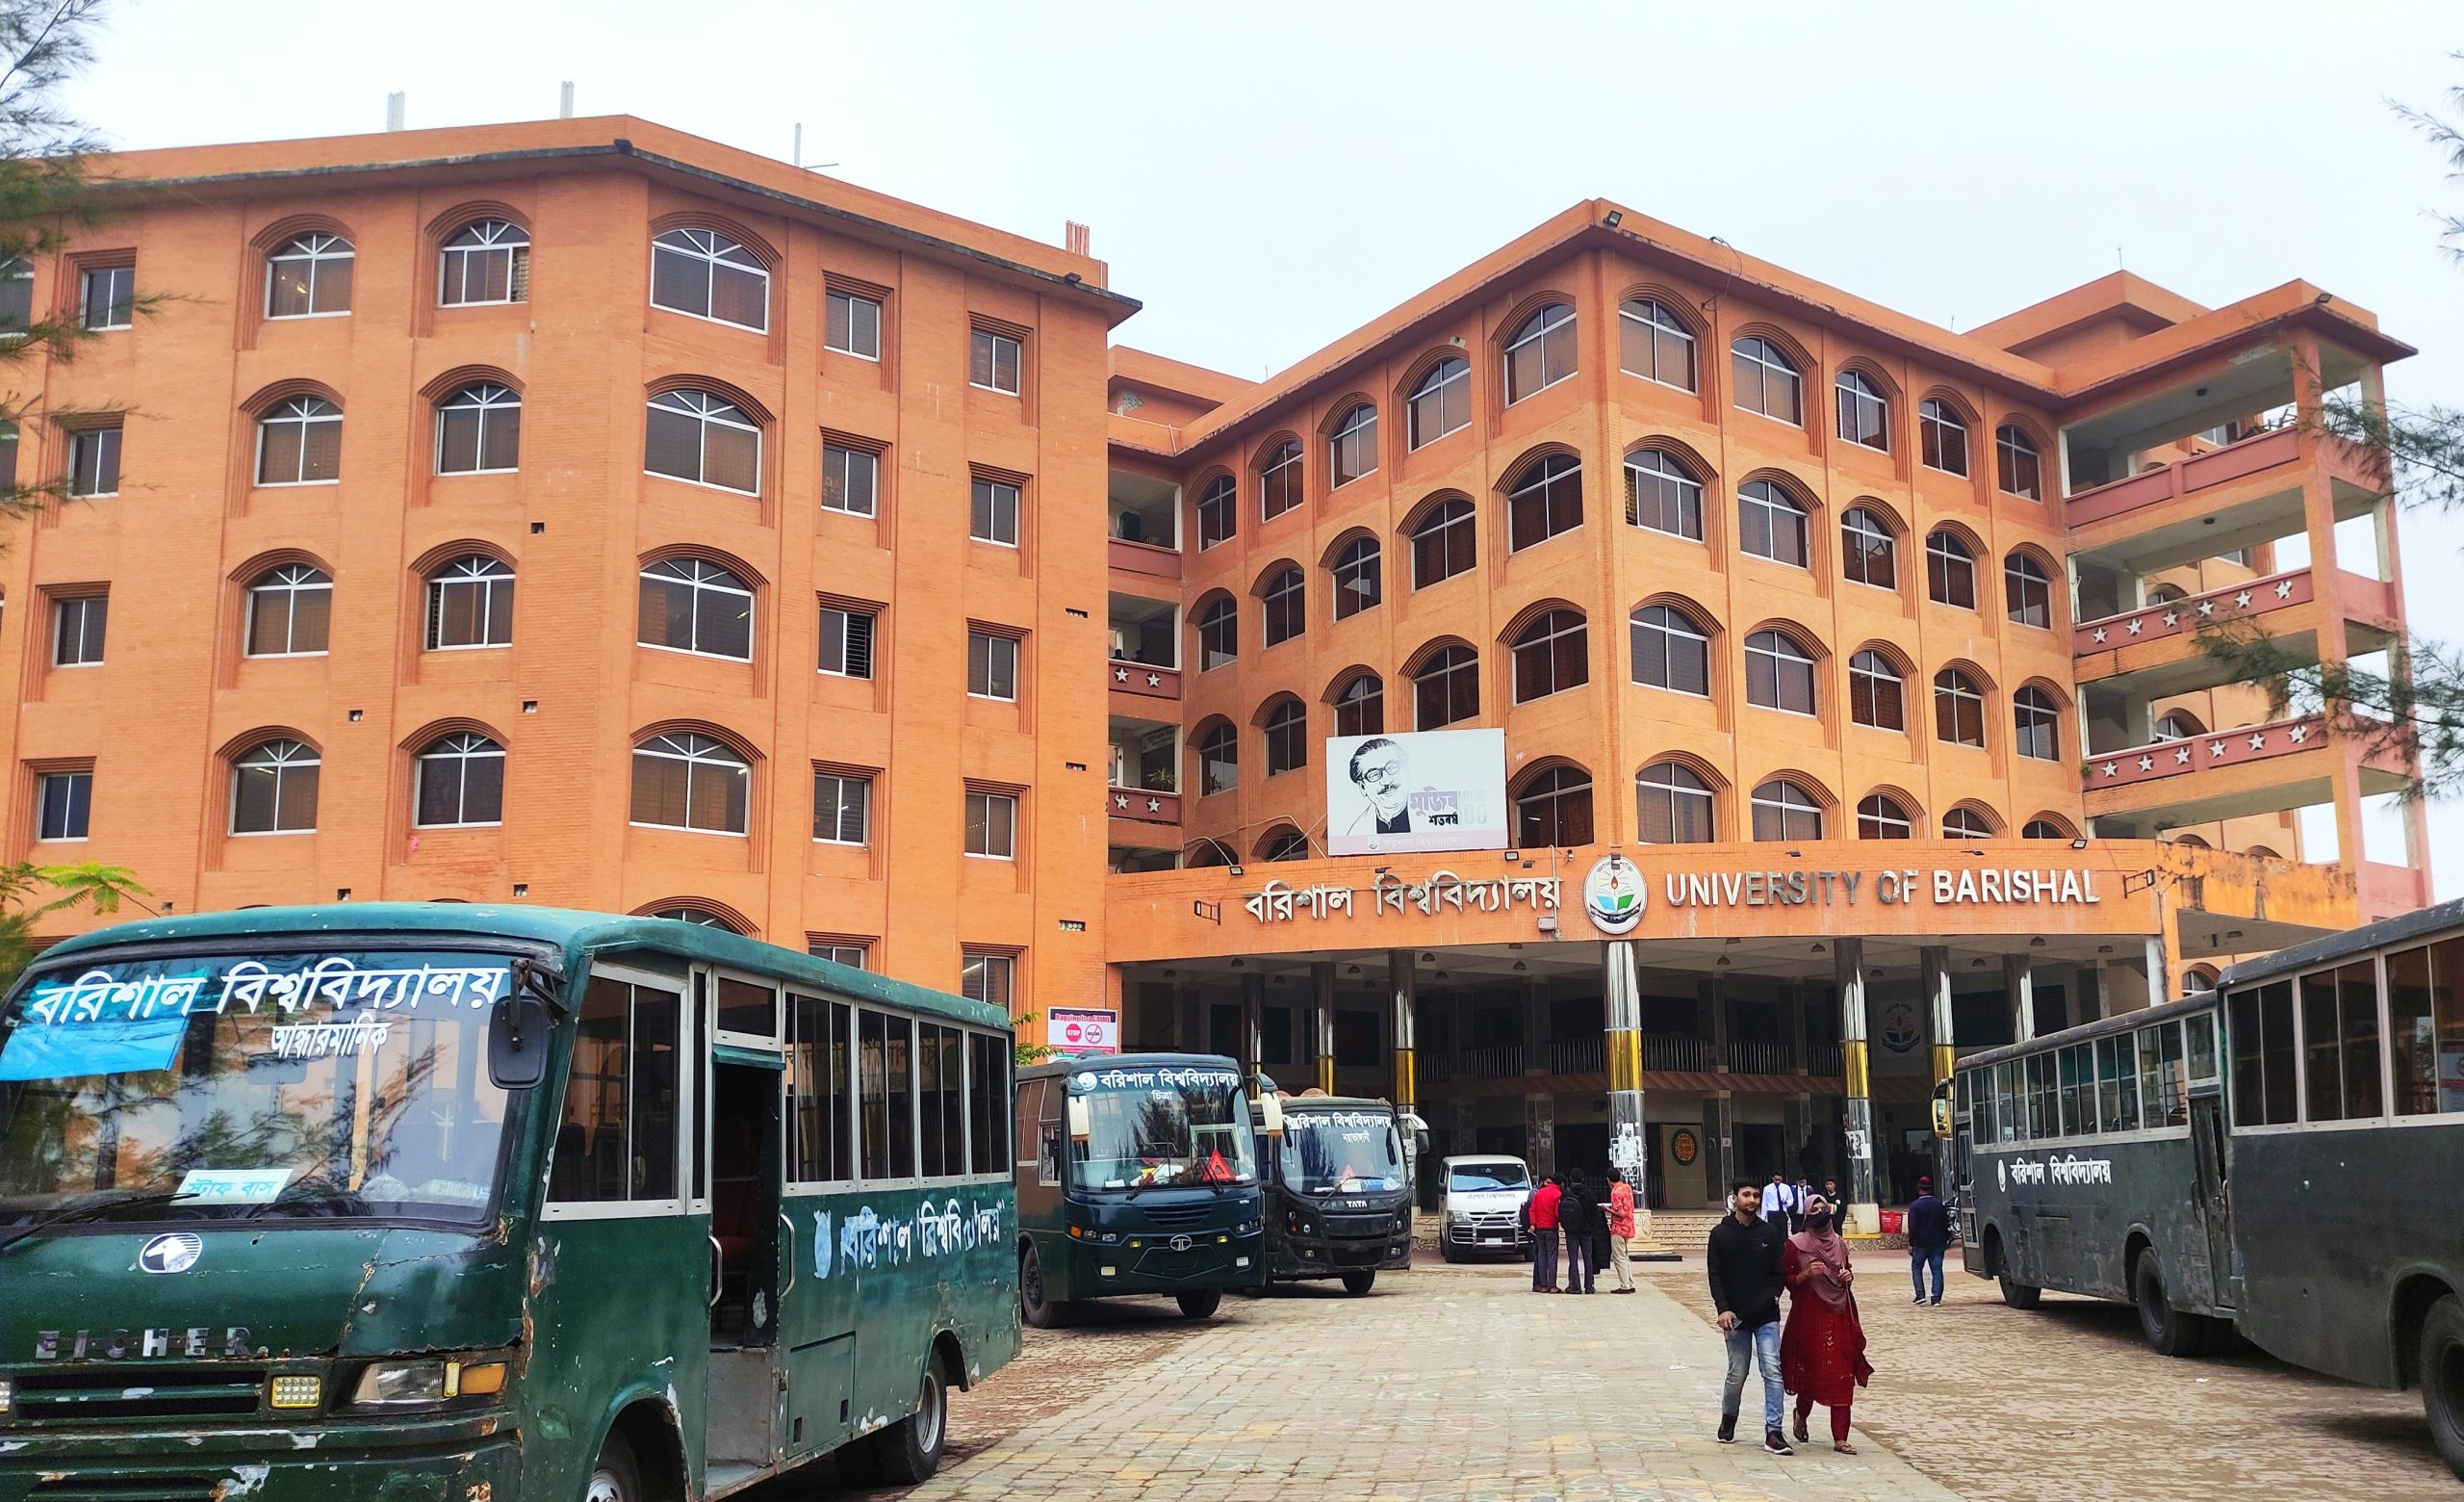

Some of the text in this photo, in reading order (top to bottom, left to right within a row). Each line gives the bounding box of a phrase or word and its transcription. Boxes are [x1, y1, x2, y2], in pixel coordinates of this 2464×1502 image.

[1428, 812, 1459, 826] শতবর্ষ
[1243, 870, 1563, 922] বরিশাল বিশ্ববিদ্যালয়
[1665, 868, 2101, 907] UNIVERSITY OF BARISHAL
[33, 957, 510, 1026] বরিশাল বিশ্ববিদ্যালয়
[1099, 1068, 1240, 1089] বরিশাল বিশ্ববিদ্যালয়
[1151, 1090, 1173, 1101] চিত্রা
[1332, 1112, 1392, 1128] বিশ্ববিদ্যালয়
[2010, 1153, 2112, 1185] বরিশাল বিশ্ববিদ্যালয়
[186, 1178, 279, 1197] স্টাফ বাস
[36, 1328, 251, 1359] EICHER
